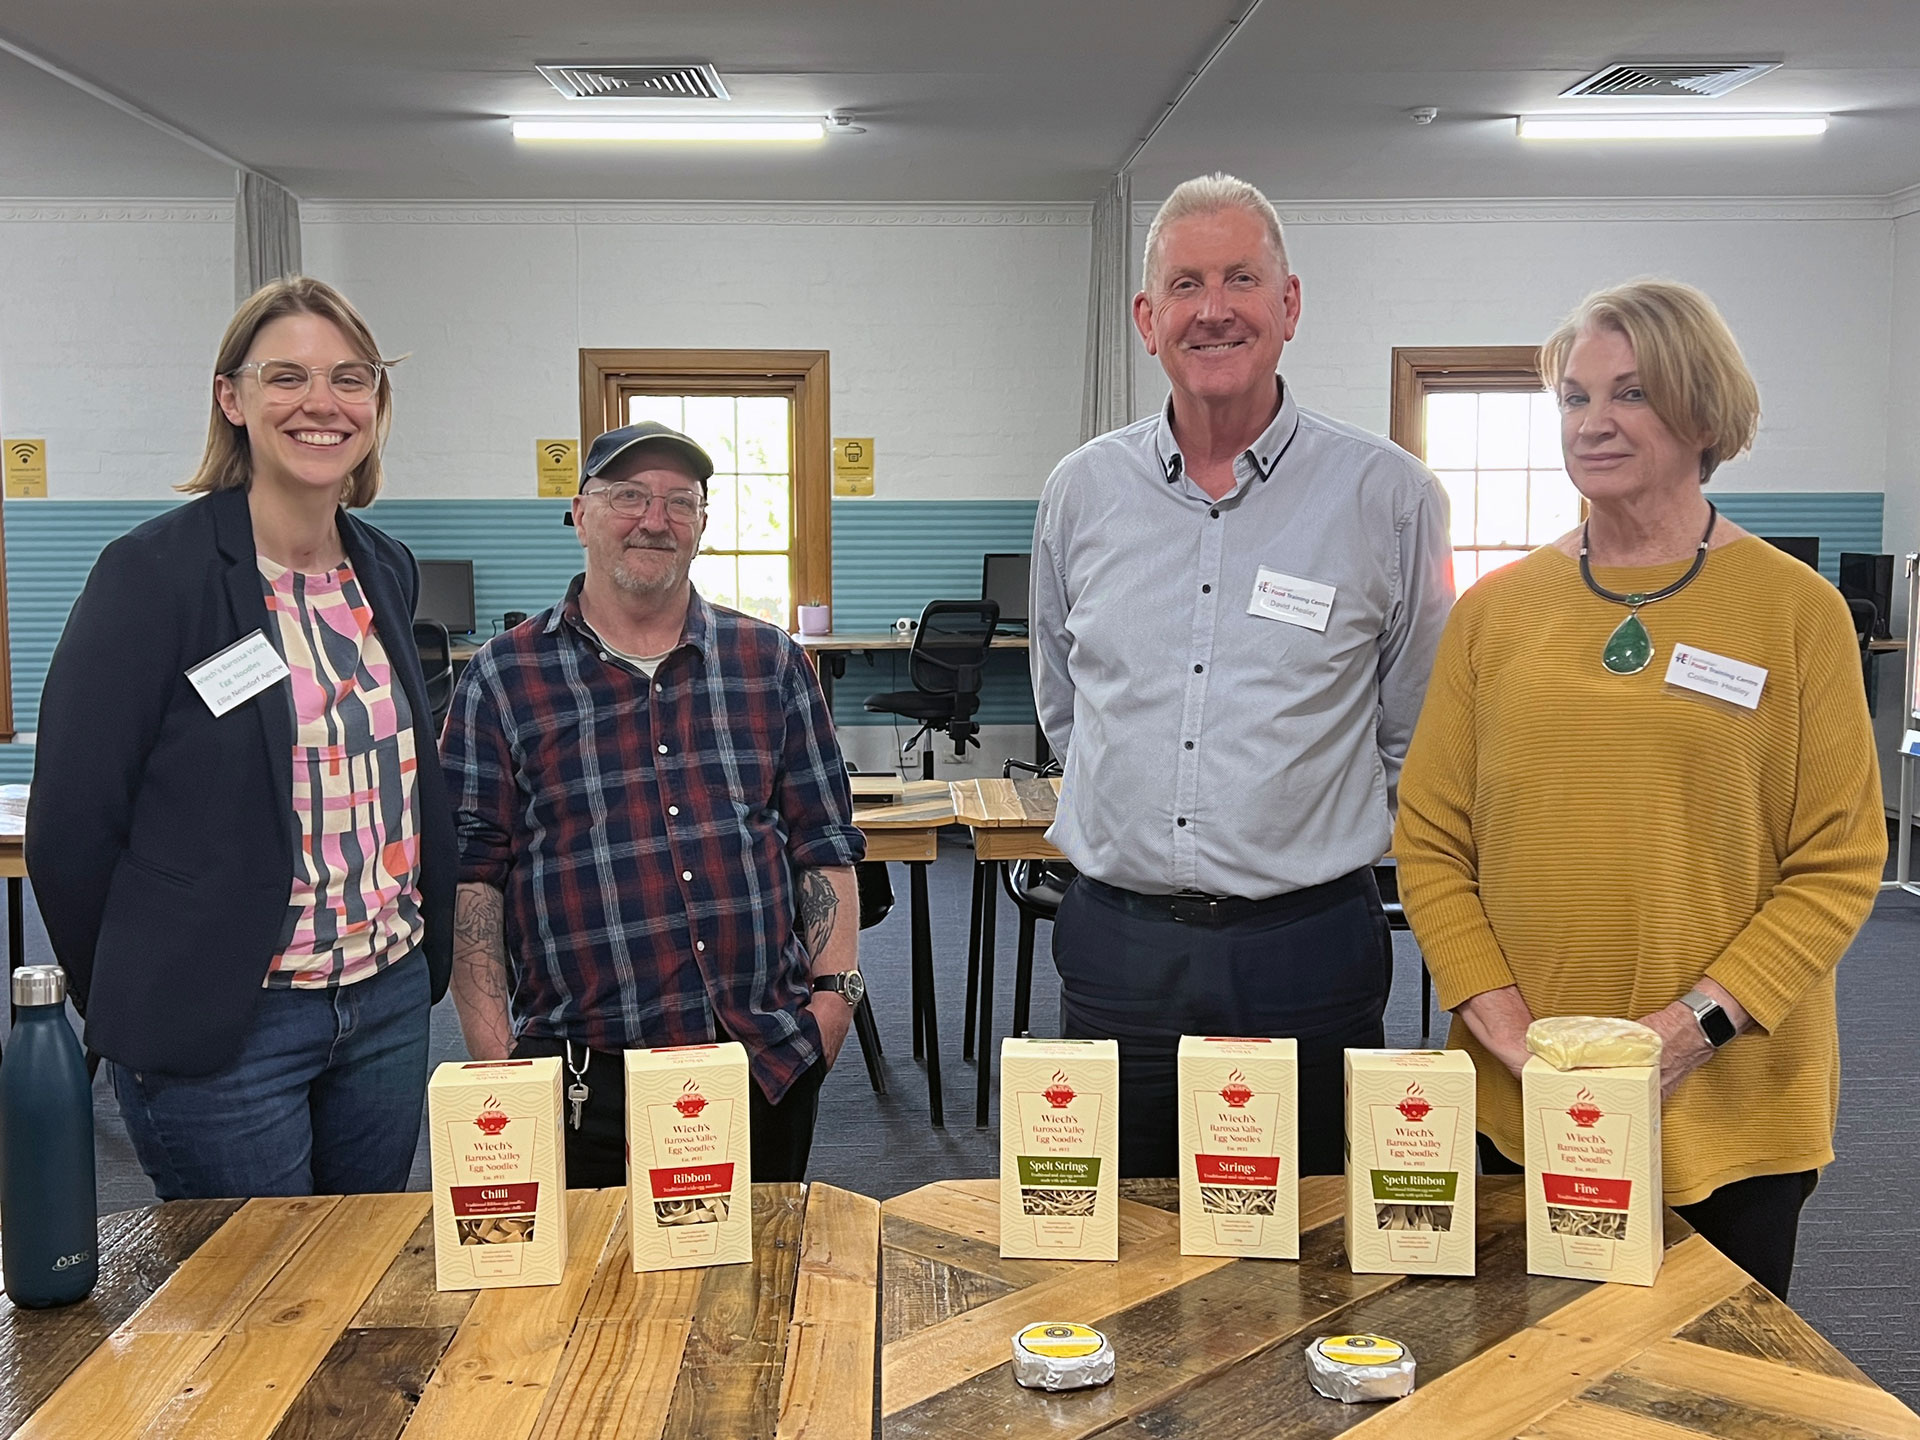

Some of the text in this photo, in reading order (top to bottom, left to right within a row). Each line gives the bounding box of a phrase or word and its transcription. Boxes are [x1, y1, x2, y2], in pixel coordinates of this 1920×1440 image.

[1270, 600, 1290, 609] David
[1287, 593, 1309, 604] Training
[1311, 599, 1329, 608] Centre
[196, 642, 267, 686] Wiech's Barossa Valley
[233, 662, 260, 678] Noodles
[1691, 662, 1707, 670] Food
[1710, 667, 1735, 680] Training
[1736, 676, 1758, 686] Centre
[1687, 672, 1718, 685] Colleen
[1041, 1115, 1078, 1124] Wiech's
[1218, 1114, 1256, 1123] Wiech's
[673, 1124, 710, 1133] Wiech's
[1064, 1126, 1085, 1134] Valley
[1210, 1124, 1262, 1134] Barossa Valley
[1396, 1128, 1434, 1137] Wiech's
[664, 1134, 717, 1145] Barossa Valley
[1036, 1135, 1082, 1144] Egg Noodles
[1214, 1134, 1260, 1143] Egg Noodles
[1566, 1133, 1606, 1143] Wiech's
[473, 1141, 513, 1151] Wiech's
[1419, 1139, 1440, 1148] Valley
[668, 1144, 715, 1155] Egg Noodles
[1390, 1149, 1439, 1158] Egg Noodles
[1557, 1143, 1613, 1156] Barossa Valley
[465, 1152, 521, 1162] Barossa Valley
[1562, 1154, 1611, 1164] Egg Noodles
[469, 1162, 519, 1173] Egg Noodles
[1030, 1160, 1088, 1173] Spelt Strings
[1219, 1162, 1256, 1174] Strings
[674, 1173, 711, 1184] Ribbon
[1383, 1175, 1445, 1186] Spelt Ribbon
[1574, 1182, 1599, 1195] Fine
[481, 1188, 509, 1200] Chilli
